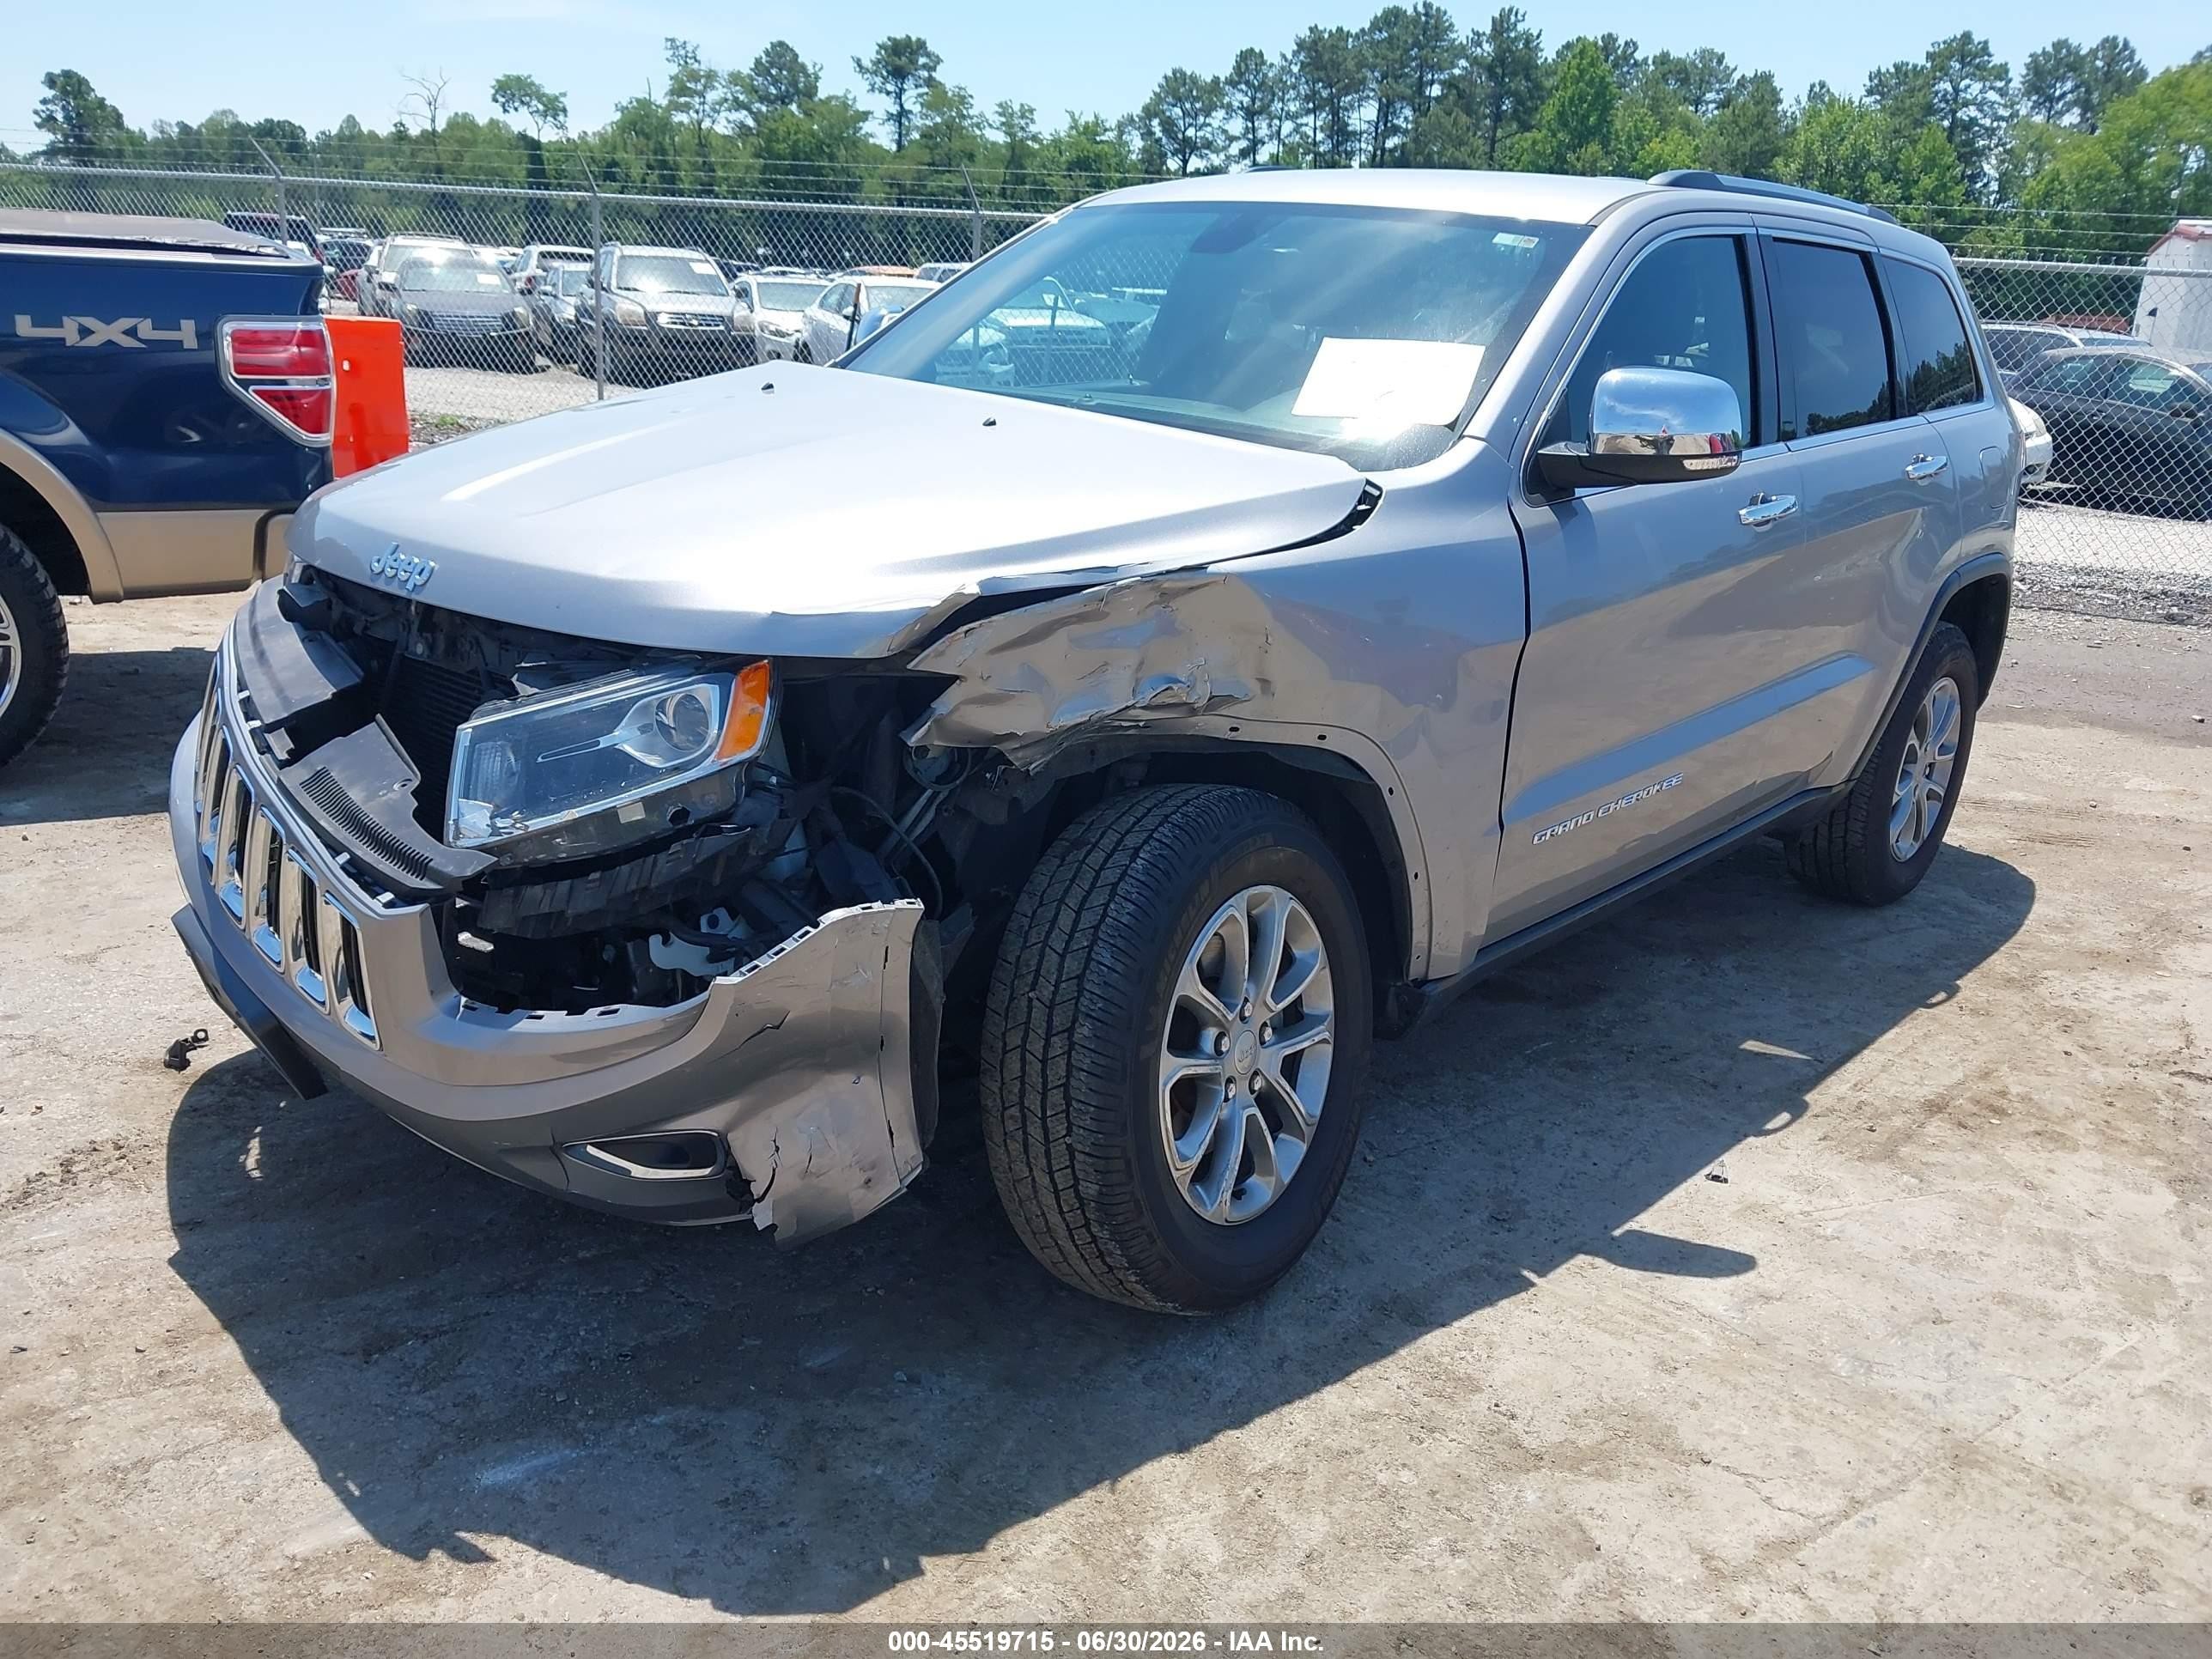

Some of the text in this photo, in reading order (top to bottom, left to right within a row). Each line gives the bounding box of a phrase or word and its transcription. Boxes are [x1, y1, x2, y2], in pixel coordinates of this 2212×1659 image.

[370, 542, 438, 592] Jeep
[1532, 773, 1684, 845] GRAND CHEROKEE
